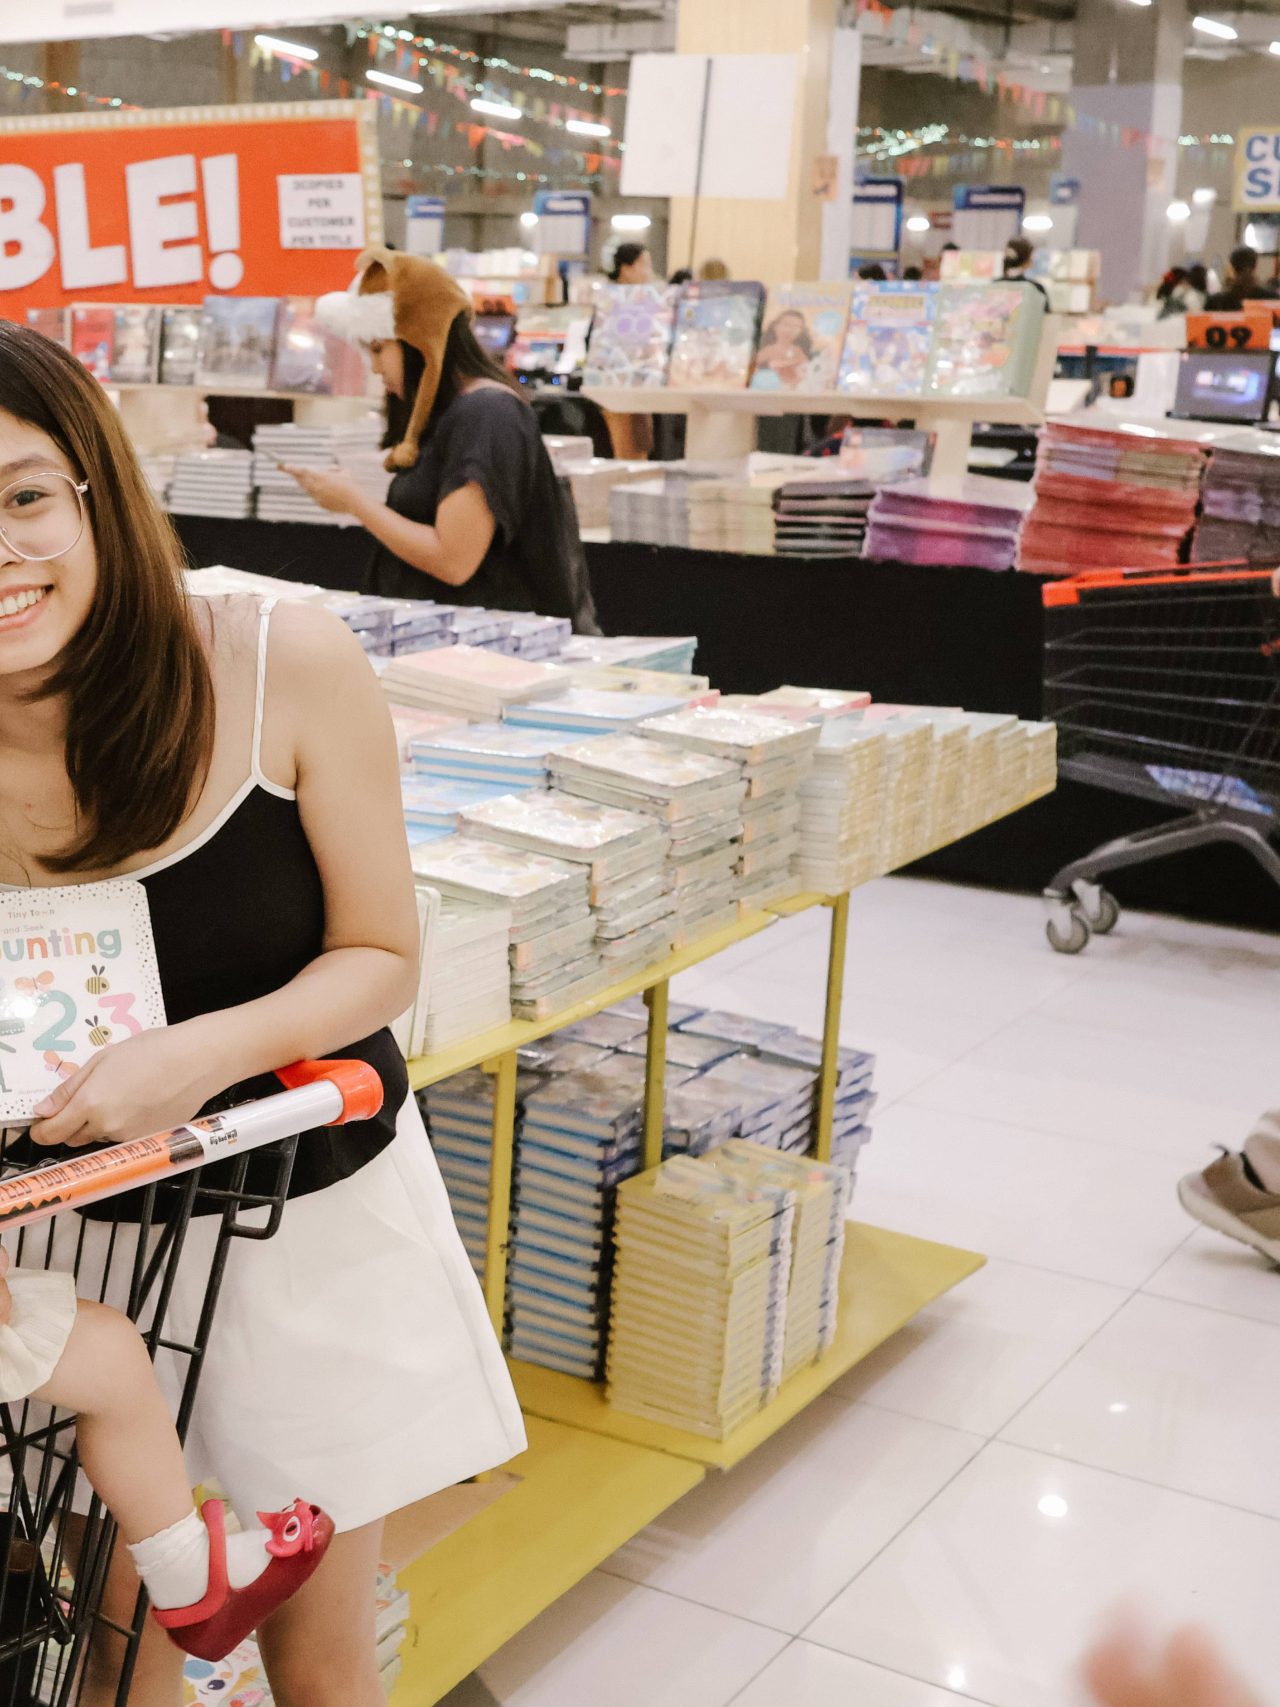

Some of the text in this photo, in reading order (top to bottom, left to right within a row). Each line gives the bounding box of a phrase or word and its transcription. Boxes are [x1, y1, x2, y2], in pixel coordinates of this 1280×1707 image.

[1245, 168, 1280, 198] S
[1205, 326, 1253, 349] 09
[32, 989, 78, 1052] 2
[97, 992, 144, 1036] 3
[32, 1167, 71, 1189] YOUR
[68, 1155, 108, 1178] NEED
